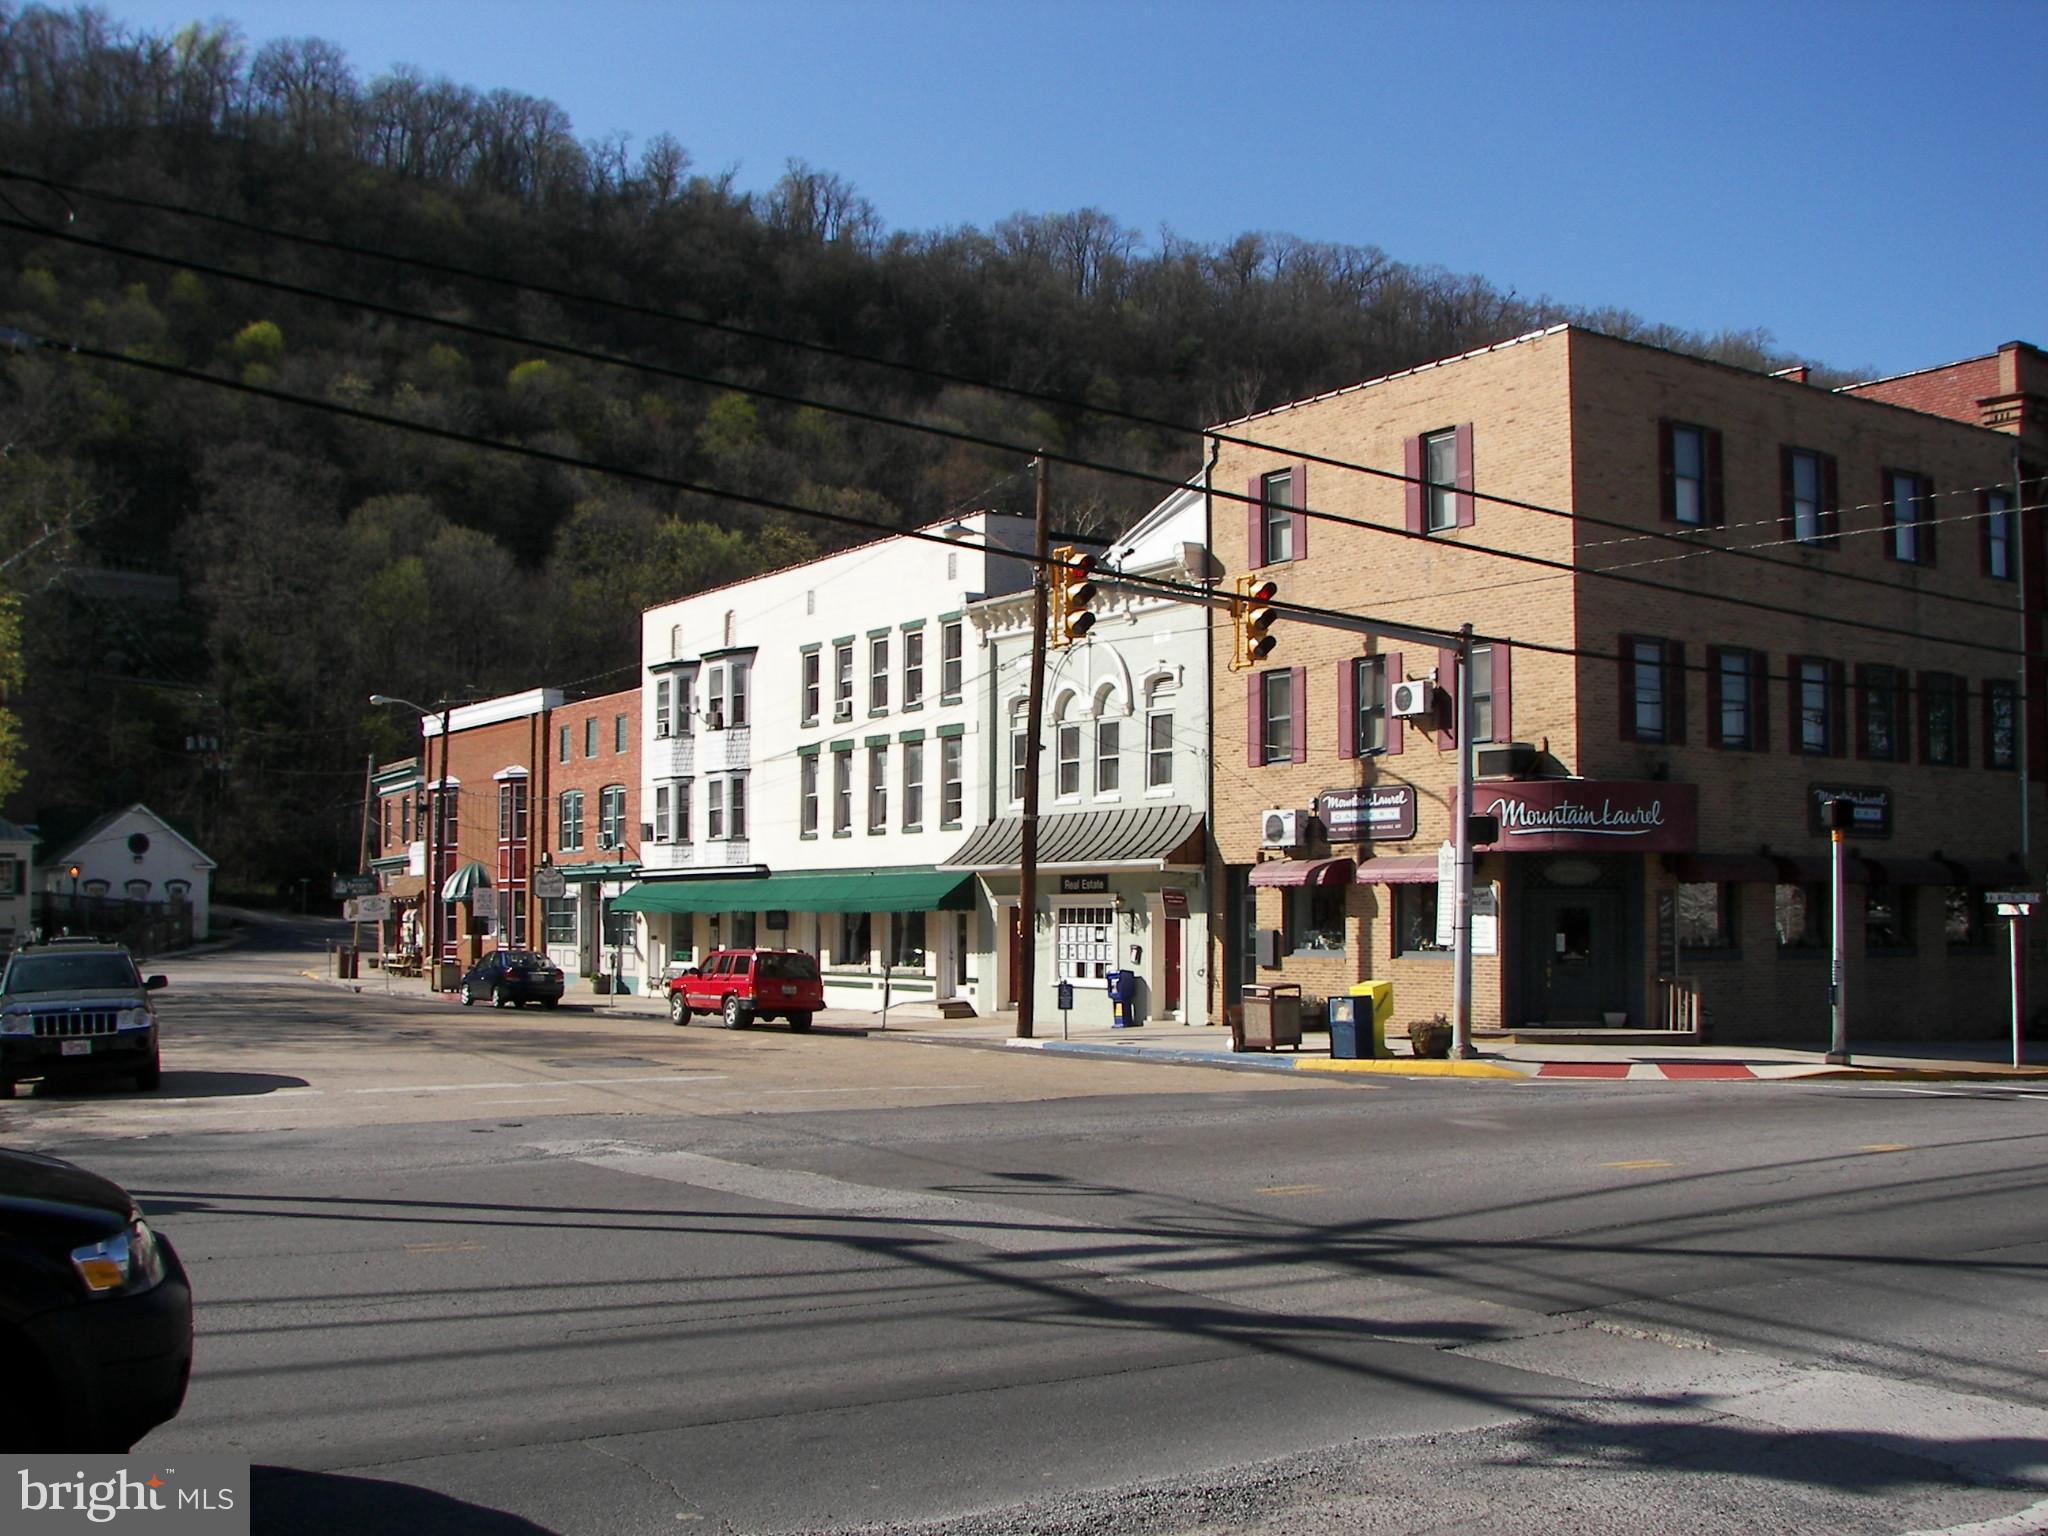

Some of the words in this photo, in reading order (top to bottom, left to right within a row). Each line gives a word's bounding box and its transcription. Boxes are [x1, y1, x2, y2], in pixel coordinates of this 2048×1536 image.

[1372, 790, 1408, 806] Laurel
[1486, 797, 1602, 827] Mountain
[1601, 799, 1665, 826] Laurel
[1064, 879, 1080, 890] Real
[1081, 878, 1105, 890] Estate
